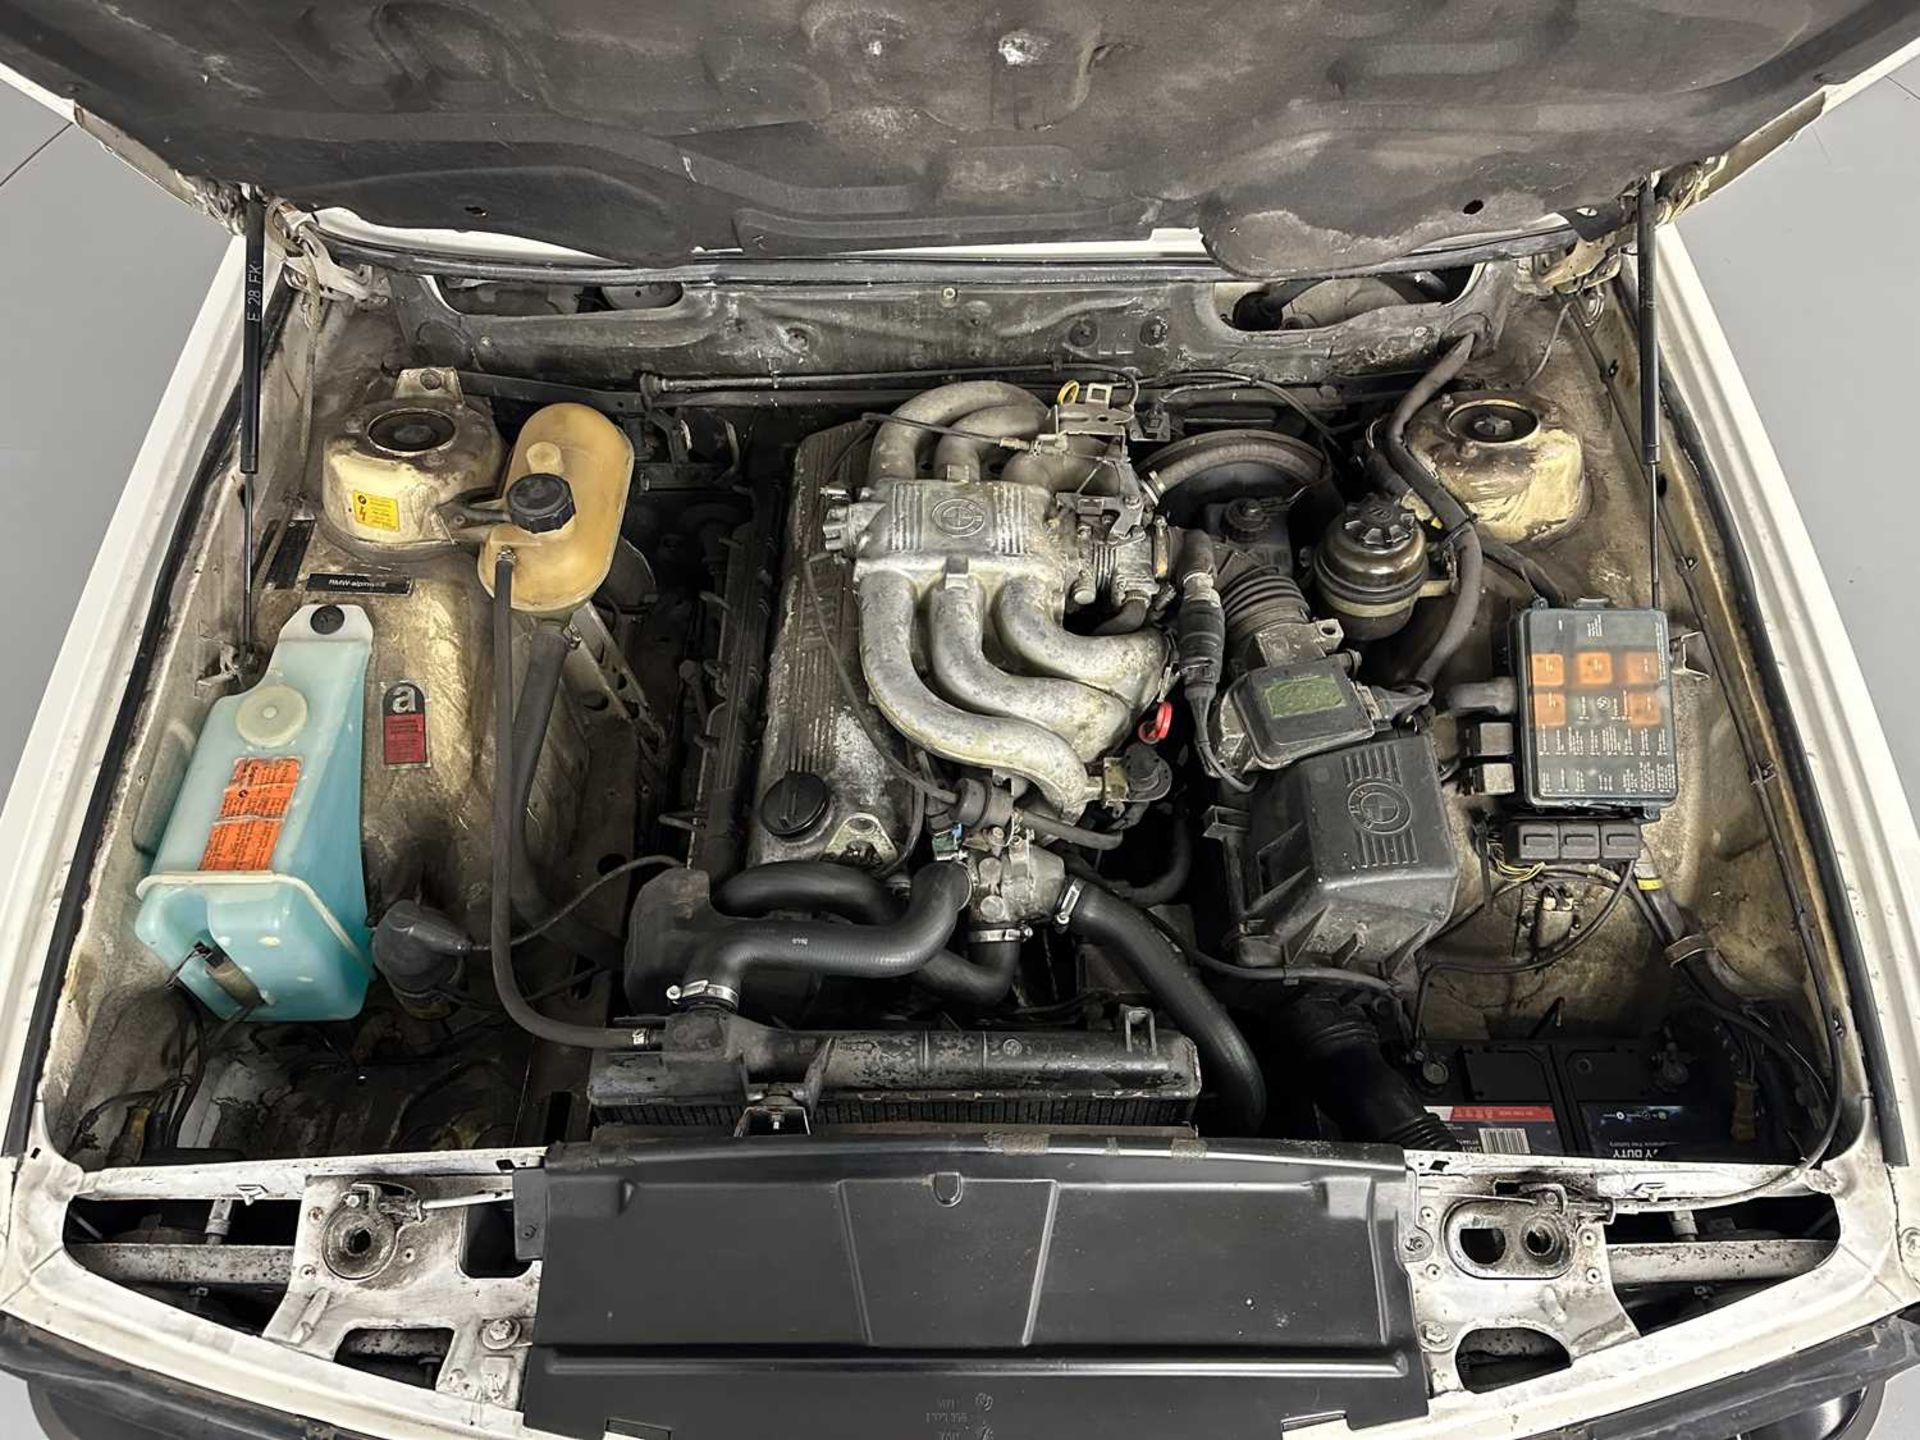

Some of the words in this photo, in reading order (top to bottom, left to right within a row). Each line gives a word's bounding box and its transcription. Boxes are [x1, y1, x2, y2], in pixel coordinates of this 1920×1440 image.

[248, 289, 262, 306] 28
[247, 311, 261, 322] E
[392, 686, 417, 714] a
[1613, 1149, 1643, 1158] DUTY
